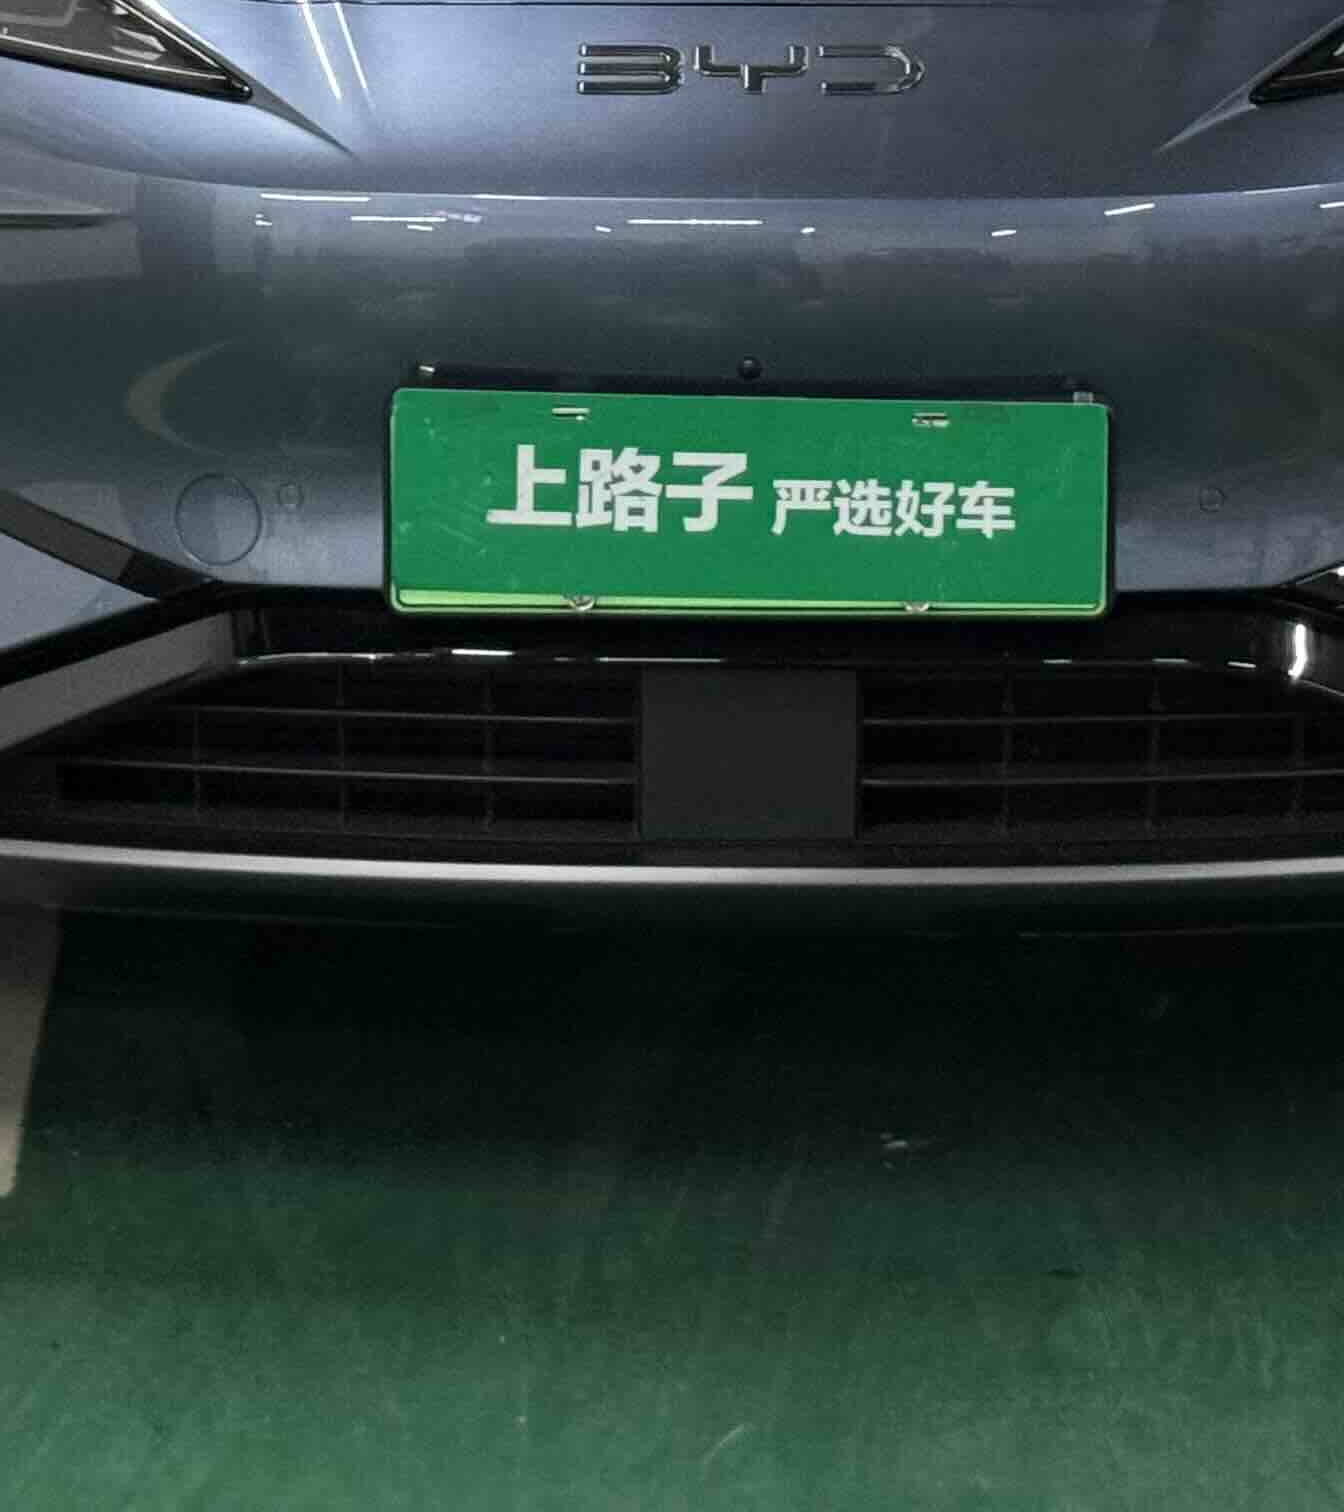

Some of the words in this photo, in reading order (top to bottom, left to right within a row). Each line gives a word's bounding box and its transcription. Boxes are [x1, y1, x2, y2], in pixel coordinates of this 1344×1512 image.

[577, 43, 926, 96] BYD
[486, 443, 754, 534] 上路子
[771, 478, 1016, 540] 严选好车
